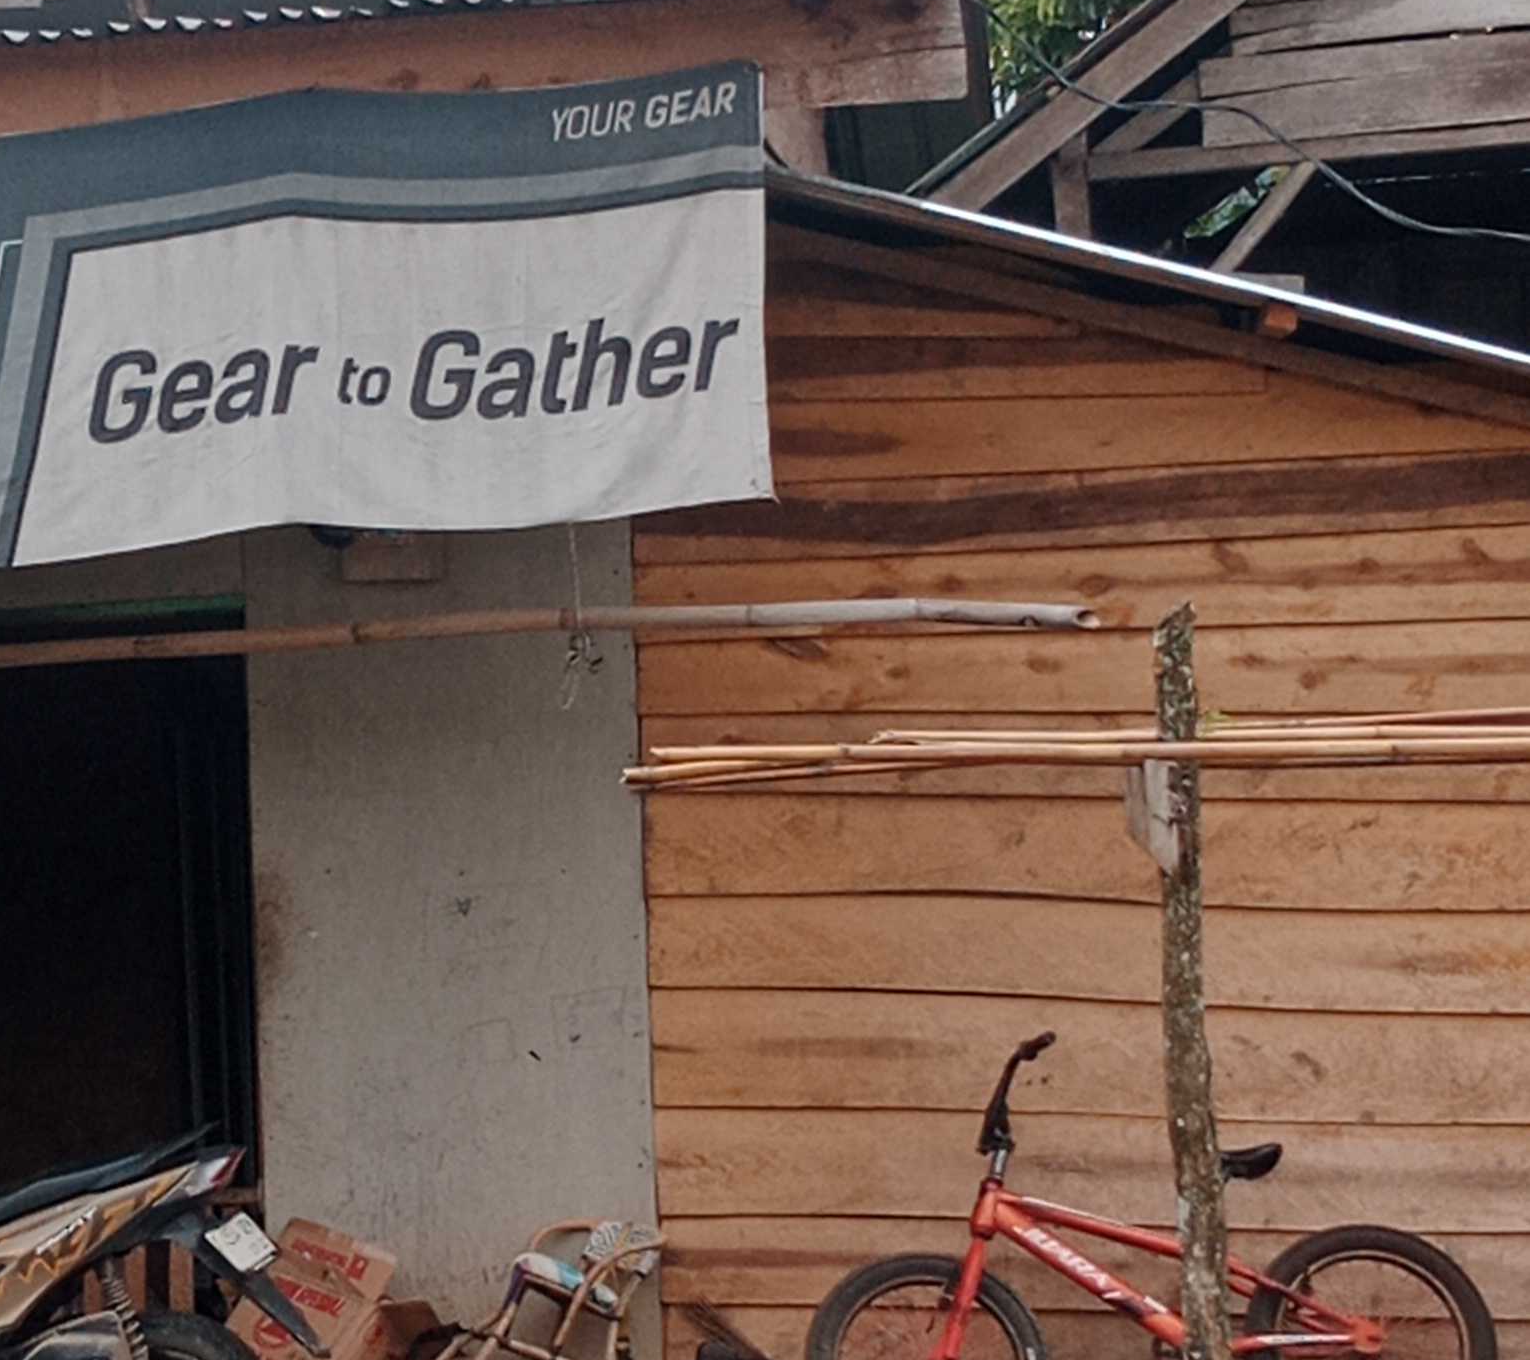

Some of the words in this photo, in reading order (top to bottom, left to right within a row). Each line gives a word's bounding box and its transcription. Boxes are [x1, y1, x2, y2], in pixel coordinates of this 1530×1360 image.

[551, 98, 636, 143] YOUR
[643, 80, 738, 129] GEAR
[87, 342, 320, 445] Gear
[337, 356, 393, 408] to
[408, 317, 740, 422] Gather
